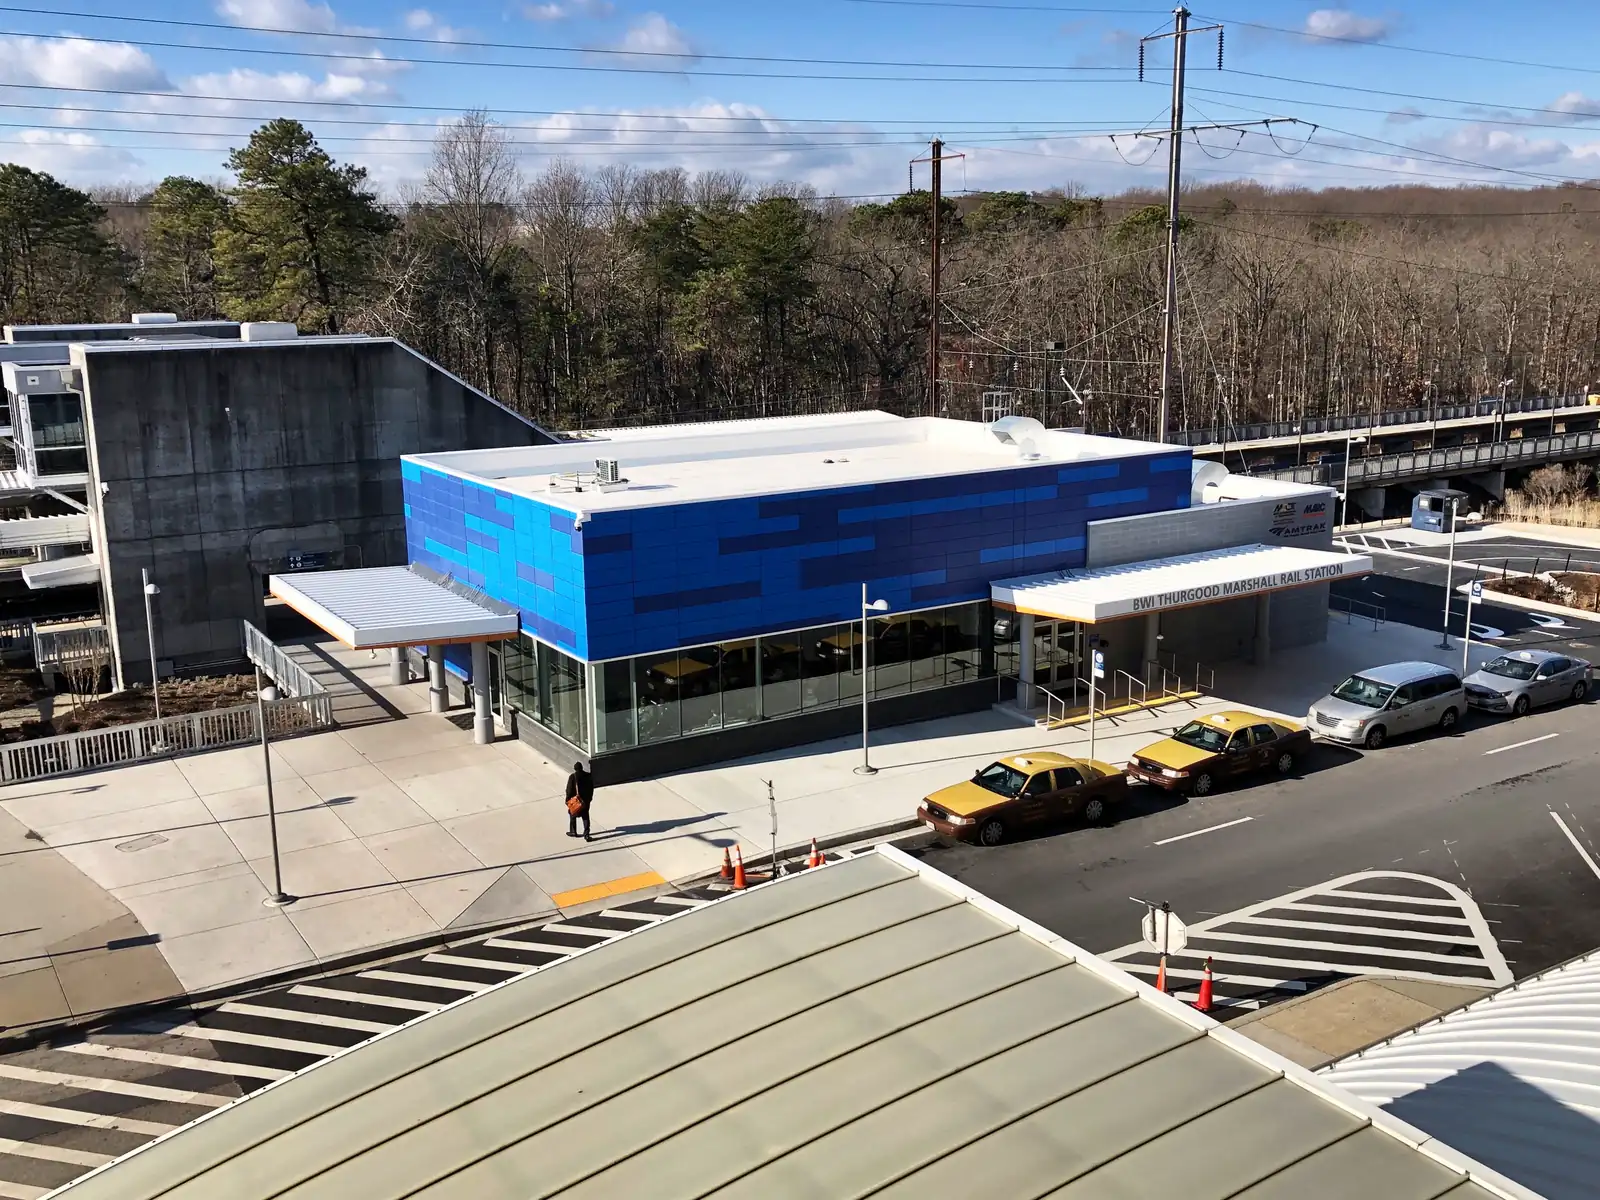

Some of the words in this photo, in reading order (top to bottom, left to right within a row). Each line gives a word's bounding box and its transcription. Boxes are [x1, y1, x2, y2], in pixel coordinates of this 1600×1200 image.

[1283, 522, 1326, 535] AMTRAK
[1132, 596, 1155, 611] BWI
[1158, 585, 1220, 606] THURGOOD
[1223, 575, 1278, 595] MARSHALL
[1280, 571, 1302, 585] RAIL
[1304, 563, 1343, 580] STATION
